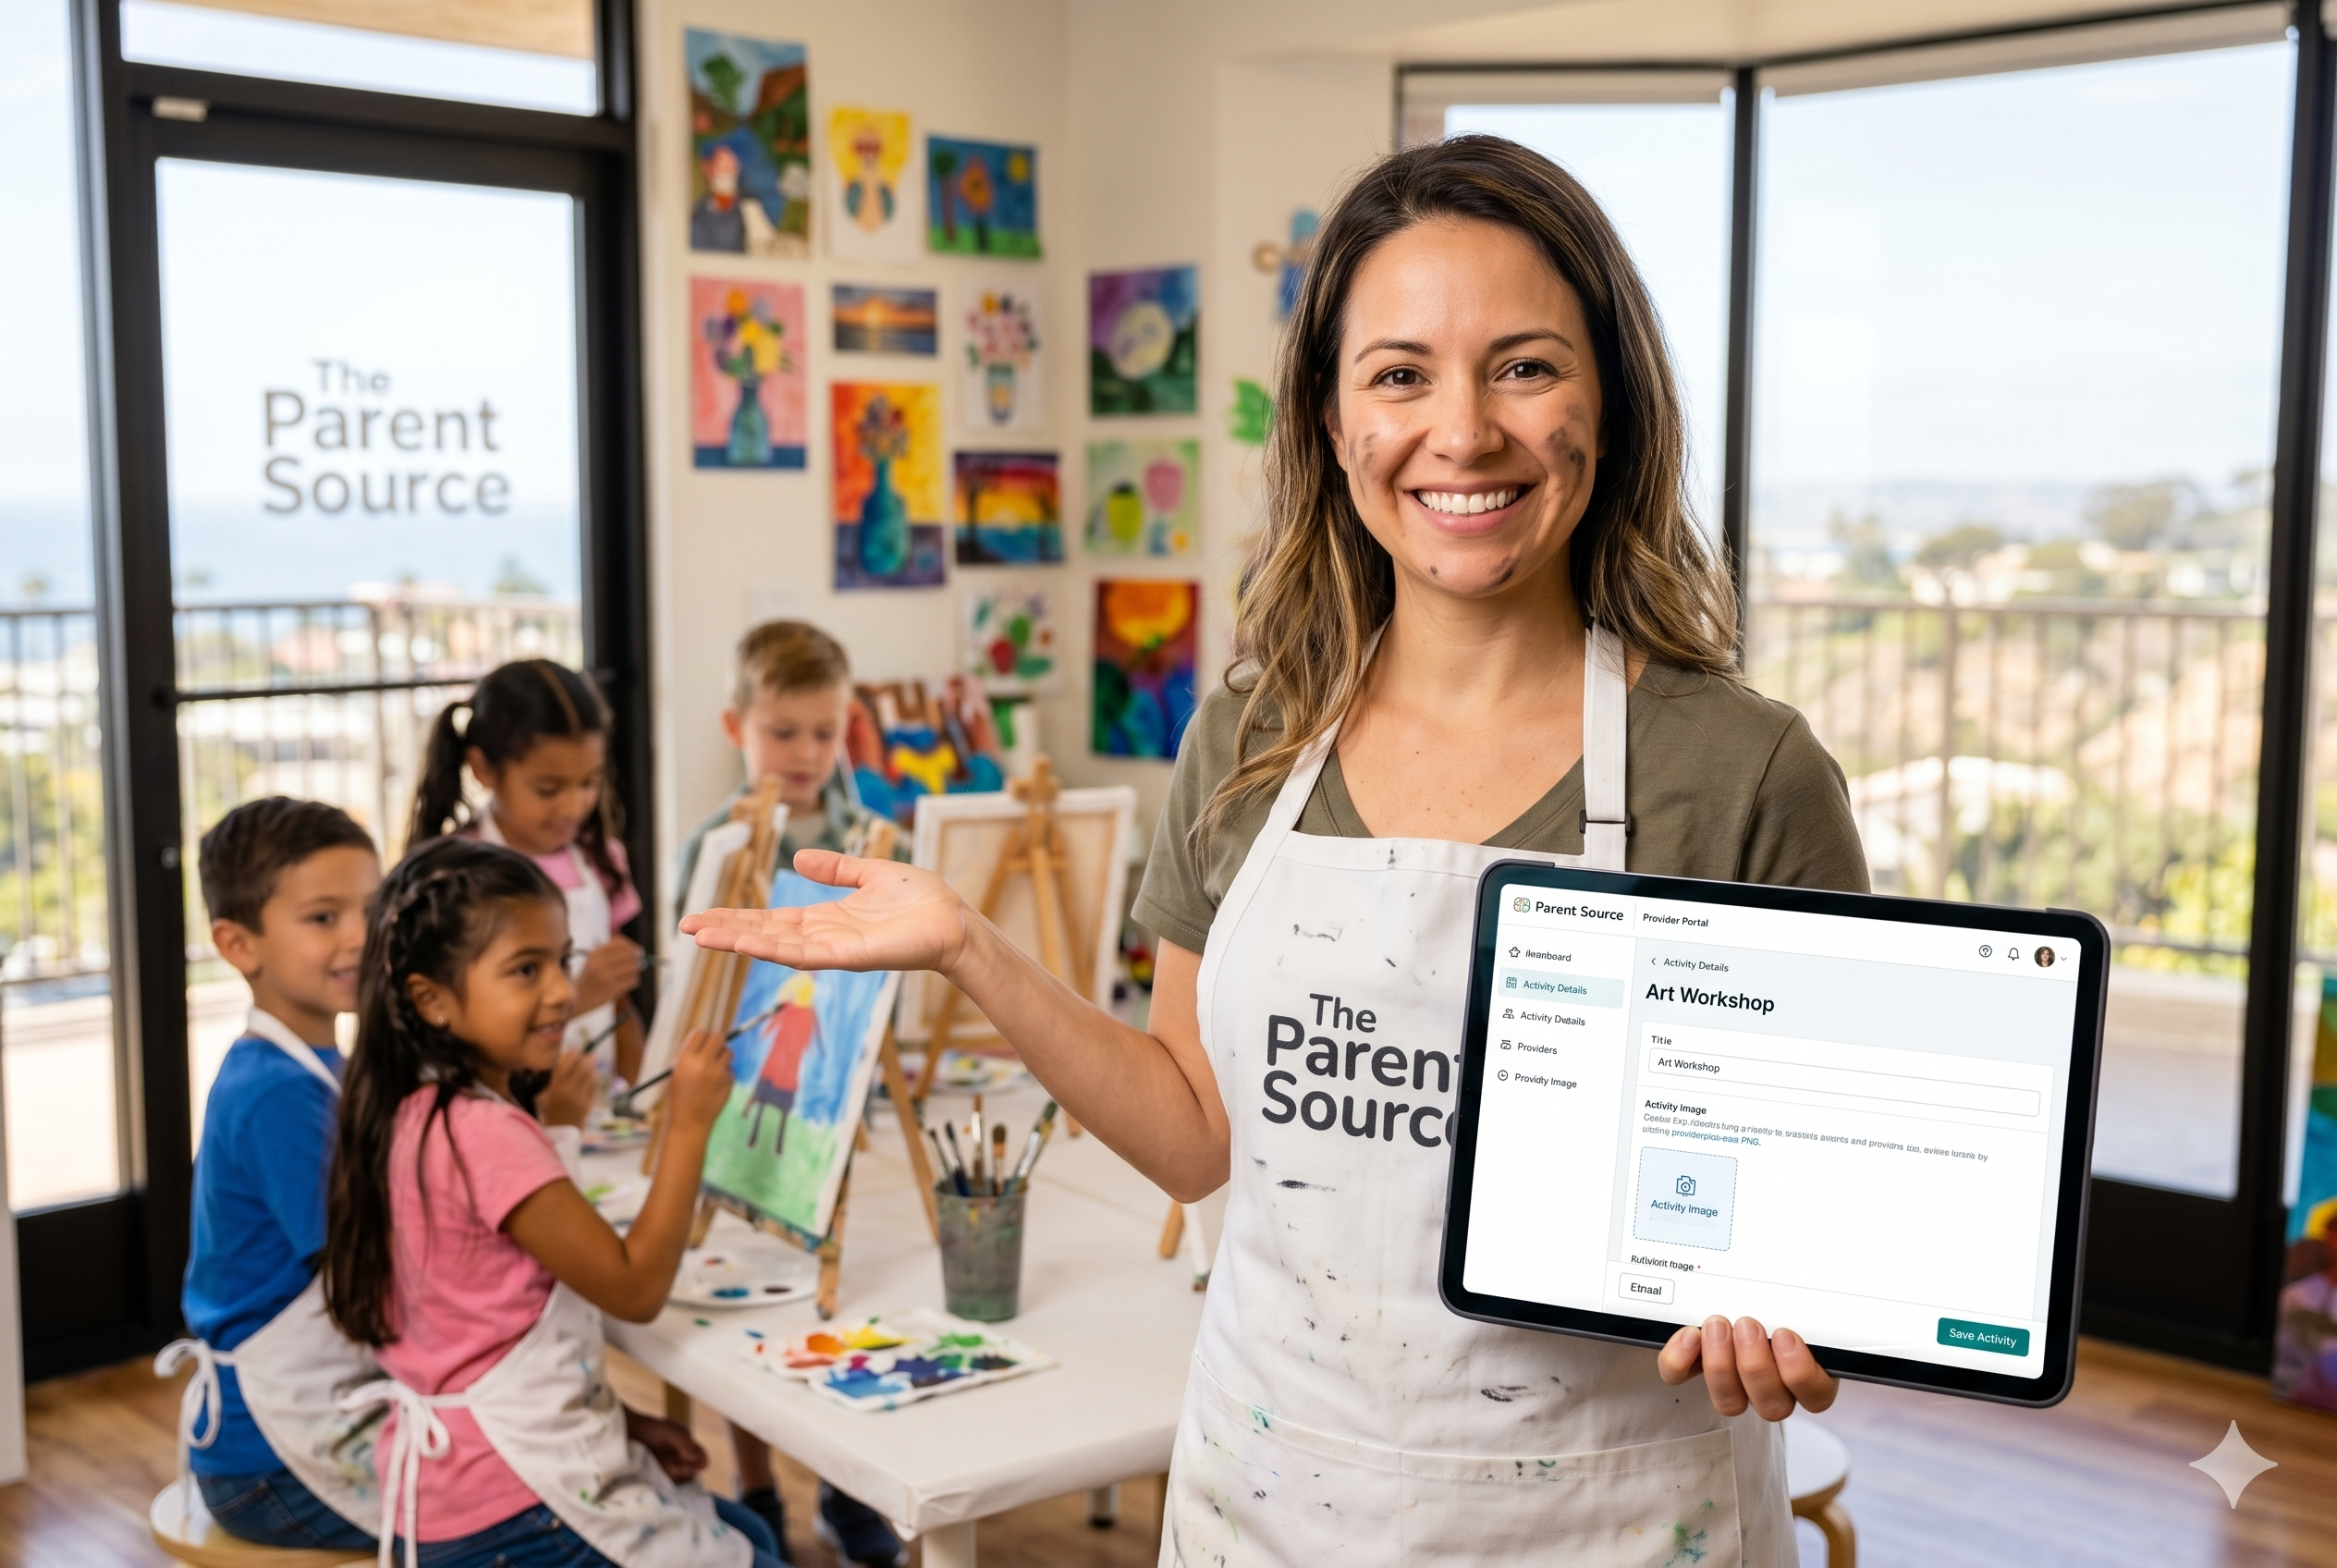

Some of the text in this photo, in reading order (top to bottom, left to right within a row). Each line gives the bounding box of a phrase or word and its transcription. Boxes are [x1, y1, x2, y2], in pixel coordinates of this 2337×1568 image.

[311, 357, 391, 394] The
[263, 388, 500, 453] Parent
[263, 455, 511, 515] Source
[1536, 901, 1624, 921] Parent Source
[1643, 913, 1709, 927] Provider Portal
[1664, 958, 1729, 972] Activity Details
[1523, 980, 1587, 995] Activity Details
[1646, 984, 1775, 1015] Art Workshop
[1309, 993, 1377, 1033] The
[1520, 1011, 1552, 1024] Activity
[1267, 1014, 1461, 1093] Paren
[1517, 1042, 1558, 1055] Providers
[1658, 1058, 1720, 1074] Art Workshop
[1550, 1077, 1577, 1089] Image
[1262, 1070, 1455, 1147] Sourc
[1645, 1099, 1707, 1116] Activity Image
[1741, 1136, 1762, 1146] PNG.
[1851, 1138, 1867, 1146] and
[1977, 1153, 1988, 1162] by
[1650, 1199, 1719, 1218] Activity Image
[1949, 1328, 2017, 1348] Save Activity
